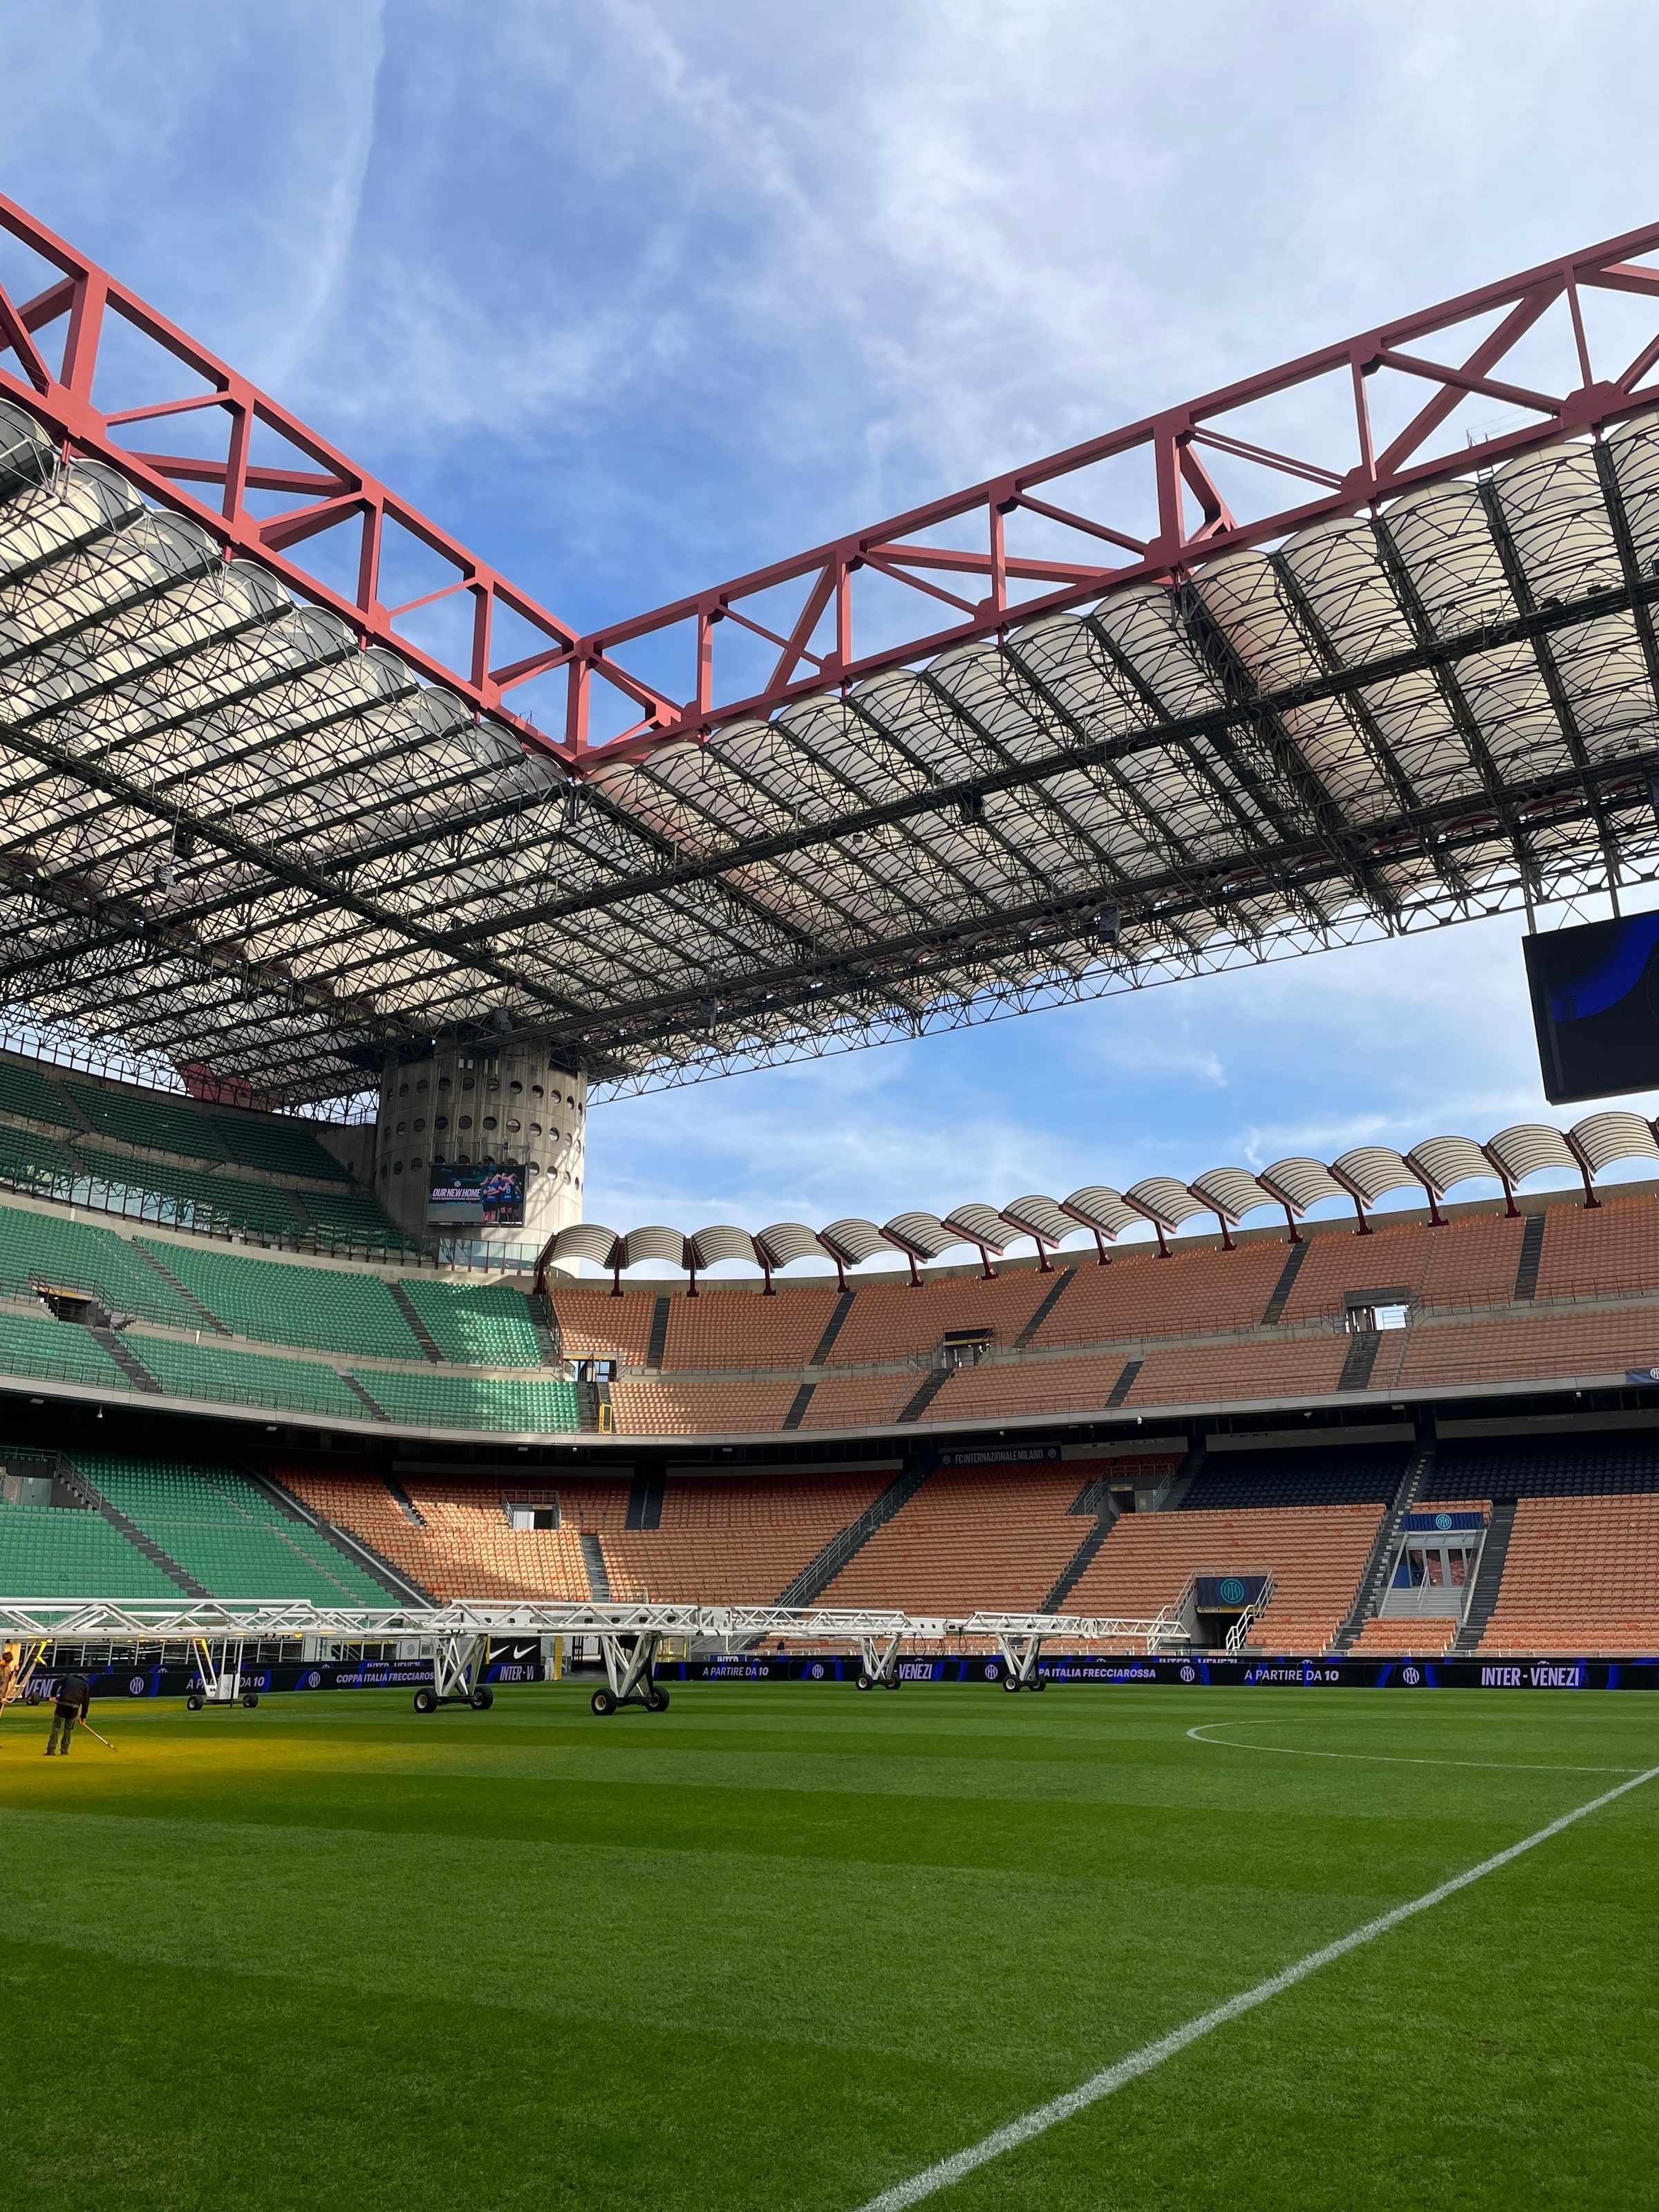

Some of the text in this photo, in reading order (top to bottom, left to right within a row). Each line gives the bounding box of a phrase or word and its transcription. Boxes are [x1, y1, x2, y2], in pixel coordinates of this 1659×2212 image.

[433, 1188, 447, 1197] OUR
[447, 1188, 462, 1197] NEW
[462, 1188, 482, 1197] HOME
[955, 1450, 1043, 1464] FC INTERNAZIONALE MILANO
[499, 1665, 523, 1681] INTER
[702, 1667, 769, 1676] A PARTIRE DA 10
[899, 1664, 932, 1680] VENEZI
[1051, 1668, 1081, 1678] ITALIA
[1082, 1668, 1156, 1678] FRECCIAROSSA
[1244, 1670, 1340, 1681] A PARTIRE DA 10
[1481, 1667, 1521, 1686] INTER
[1530, 1667, 1580, 1687] VENEZI
[254, 1676, 265, 1687] 10
[336, 1674, 363, 1683] COPPA
[363, 1673, 388, 1683] ITALIA
